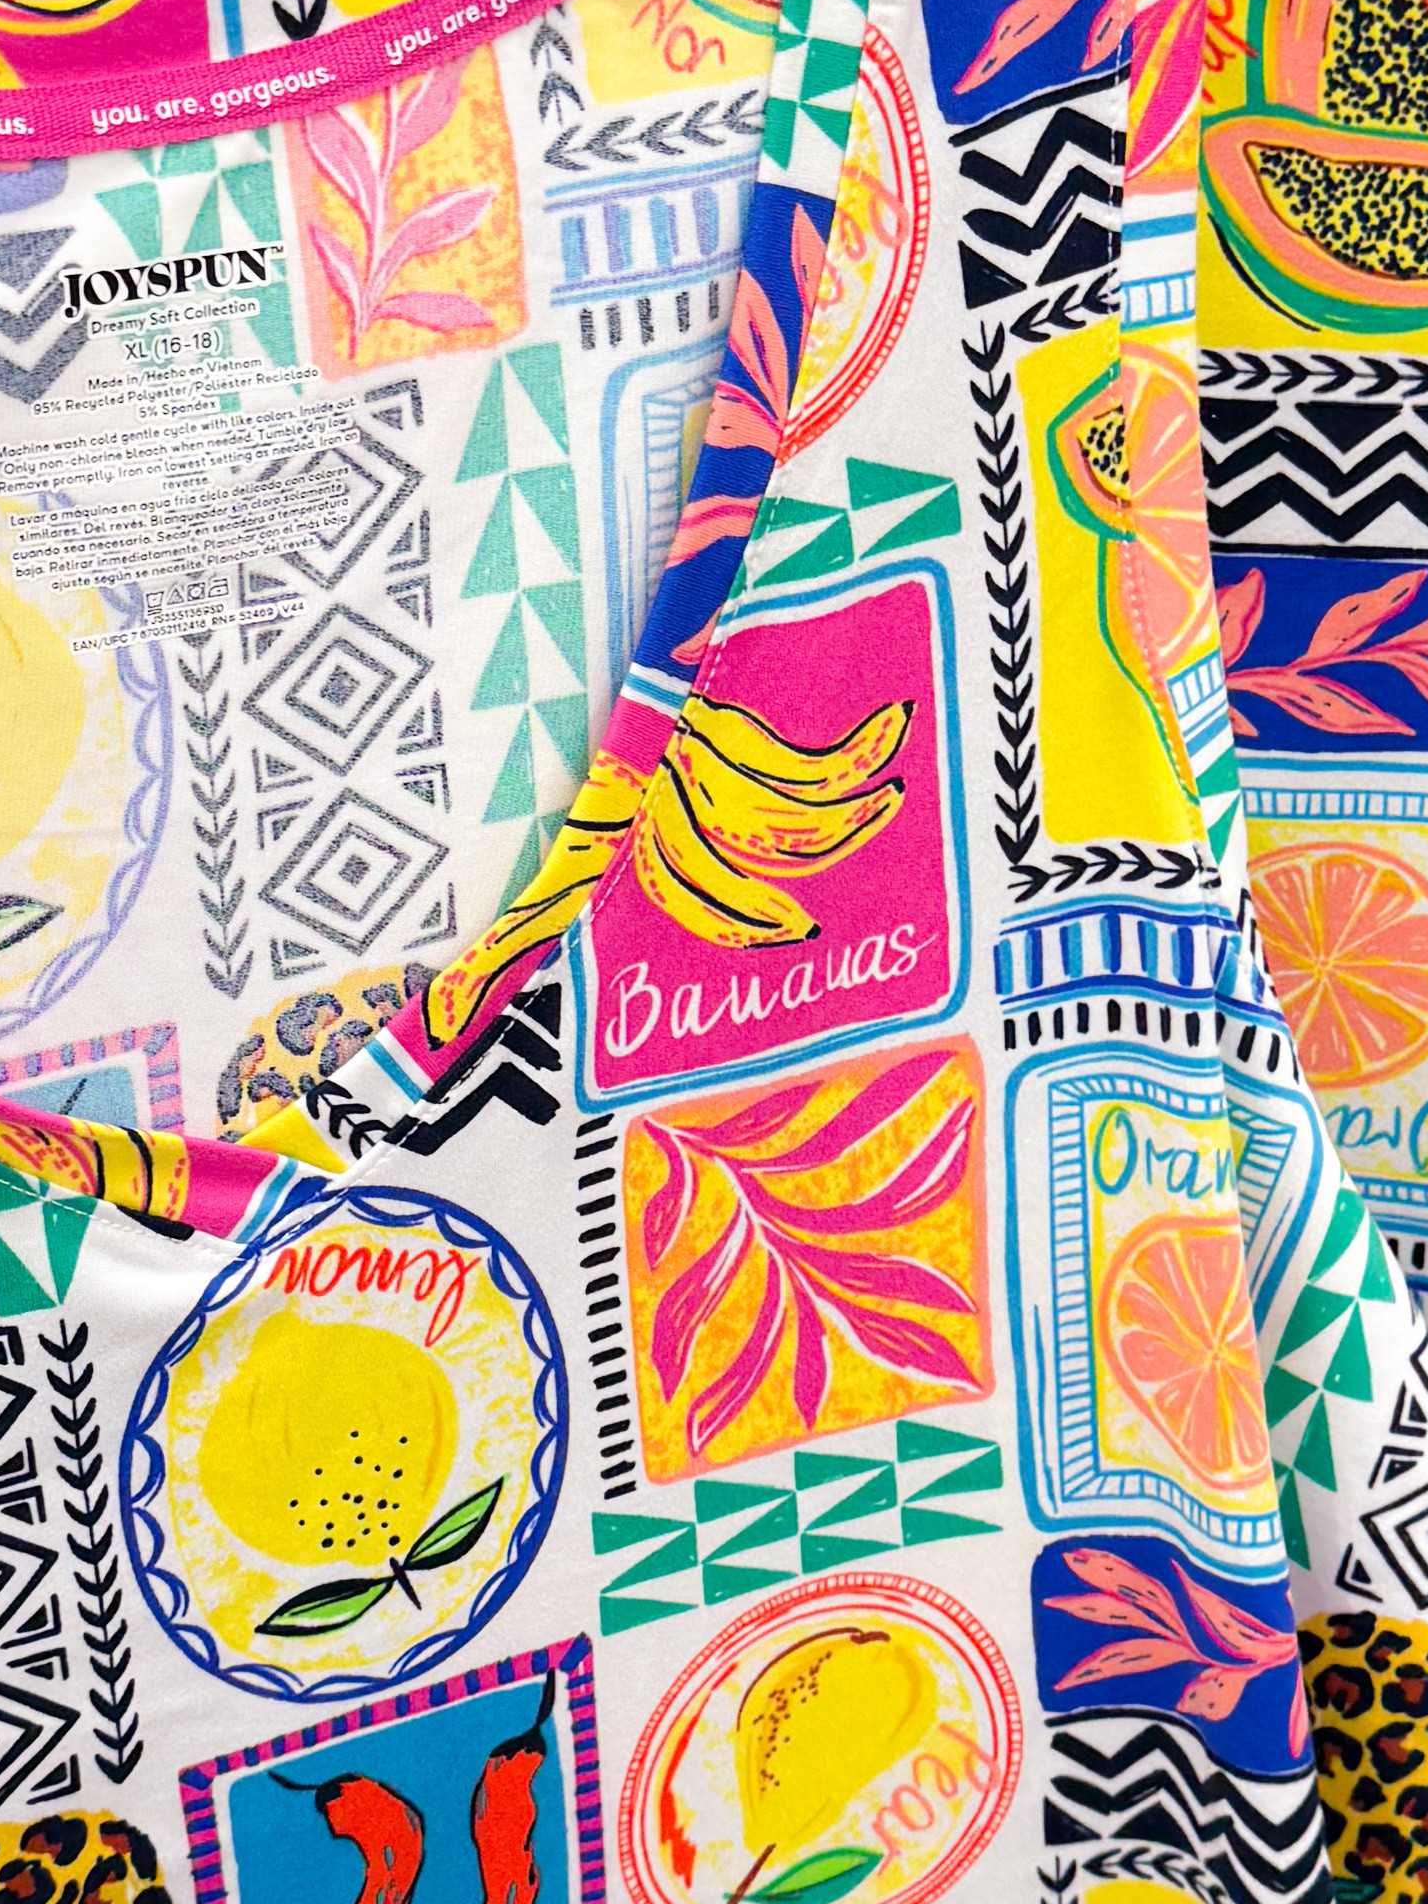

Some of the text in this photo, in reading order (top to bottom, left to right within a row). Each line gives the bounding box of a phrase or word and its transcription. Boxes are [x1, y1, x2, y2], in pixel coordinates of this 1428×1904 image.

[384, 26, 440, 66] you.
[441, 3, 488, 37] are.
[91, 67, 338, 134] you. are. gorgeous.
[91, 300, 256, 333] Dreamy Soft Collection
[124, 330, 220, 360] XL (16-18)
[33, 401, 61, 414] 95%
[65, 392, 124, 411] Recycled
[256, 366, 318, 384] Reciclado
[88, 358, 262, 390] Made in/Hecho en Vietnam
[138, 399, 216, 418] 5% Spandex
[53, 436, 86, 450] wash
[89, 432, 117, 445] cold
[120, 427, 159, 445] gentle
[163, 421, 197, 438] cycle
[201, 416, 228, 430] with
[3, 461, 36, 474] Only
[39, 450, 122, 469] non-chlorine
[125, 443, 167, 458] bleach
[170, 440, 205, 453] when
[118, 466, 143, 477] Iron
[146, 464, 161, 474] on
[164, 455, 205, 471] lowest
[209, 450, 252, 464] setting
[10, 514, 46, 526] Lavar
[12, 545, 60, 560] cuando
[49, 559, 93, 572] Retirar
[603, 923, 941, 1058] Bananas
